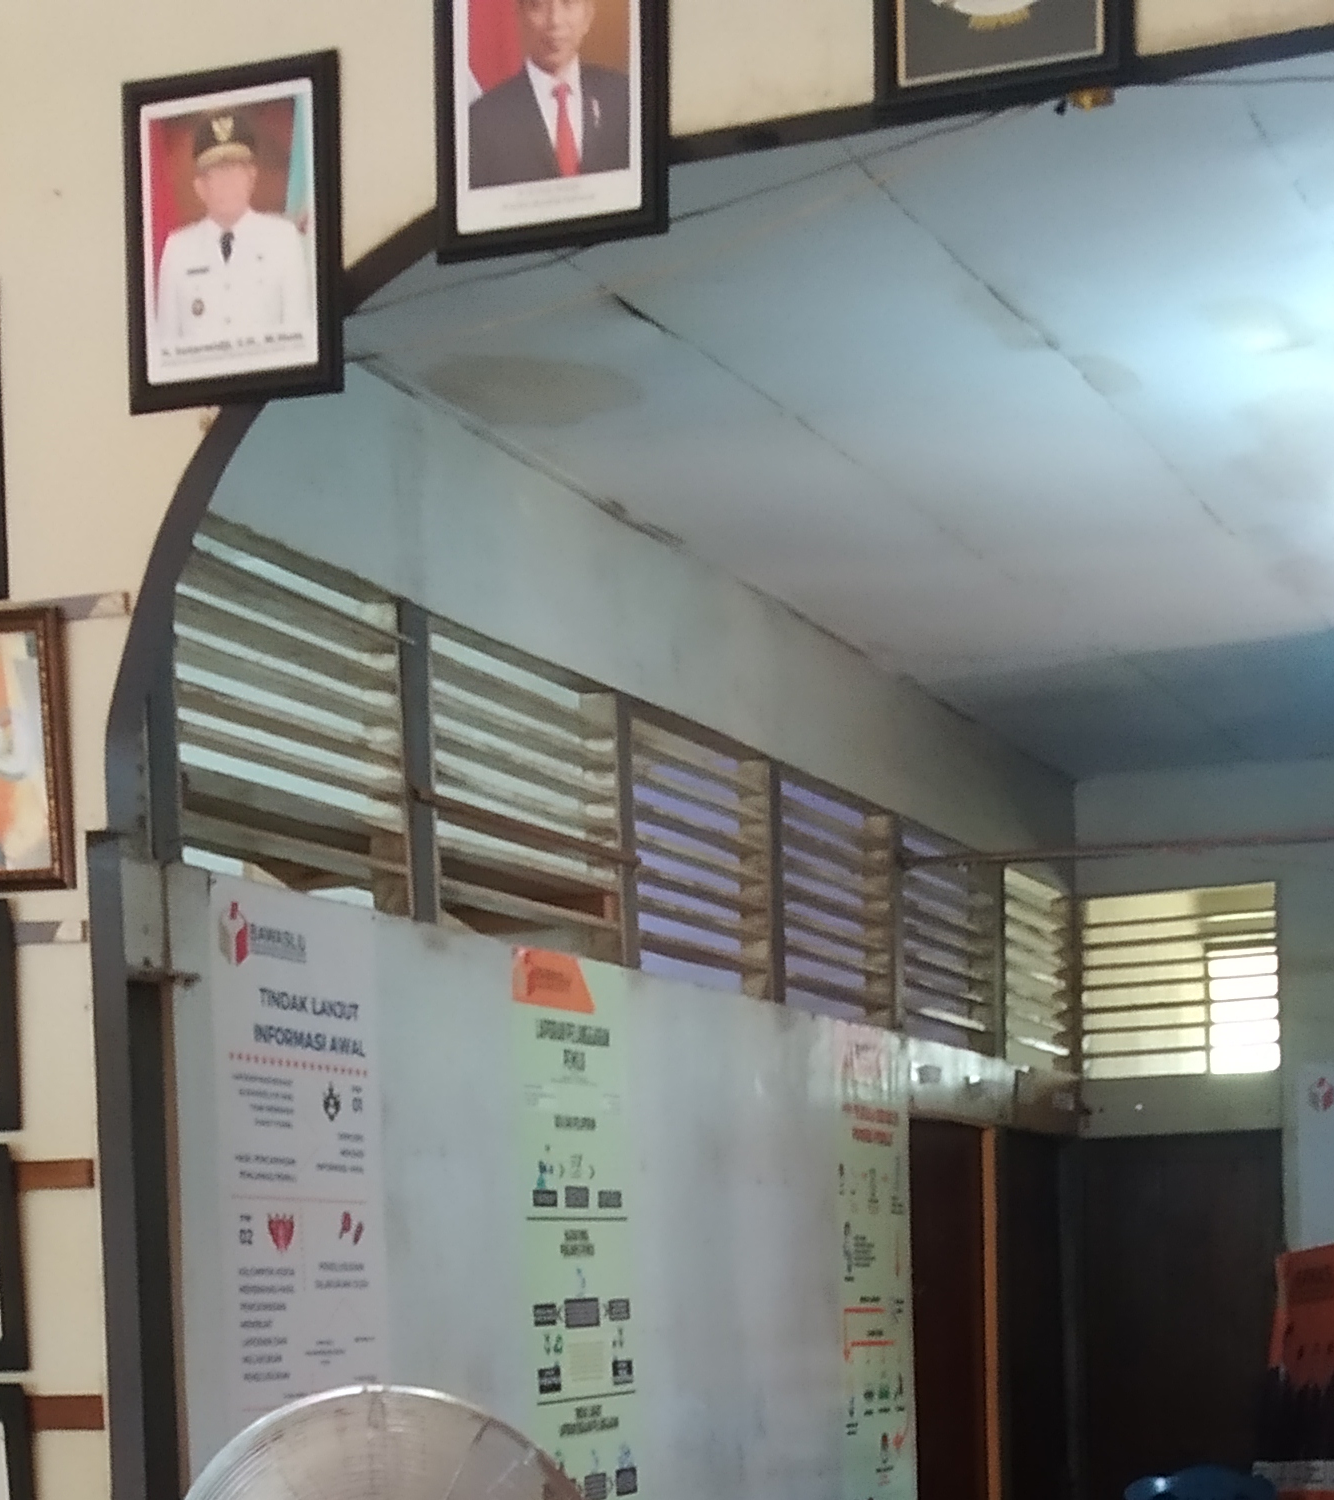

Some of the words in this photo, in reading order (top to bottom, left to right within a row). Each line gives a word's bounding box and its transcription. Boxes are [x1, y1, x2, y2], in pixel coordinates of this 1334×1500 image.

[258, 985, 309, 1015] TINDAK
[253, 1022, 327, 1052] INFORMASI
[329, 1036, 366, 1059] AWAL
